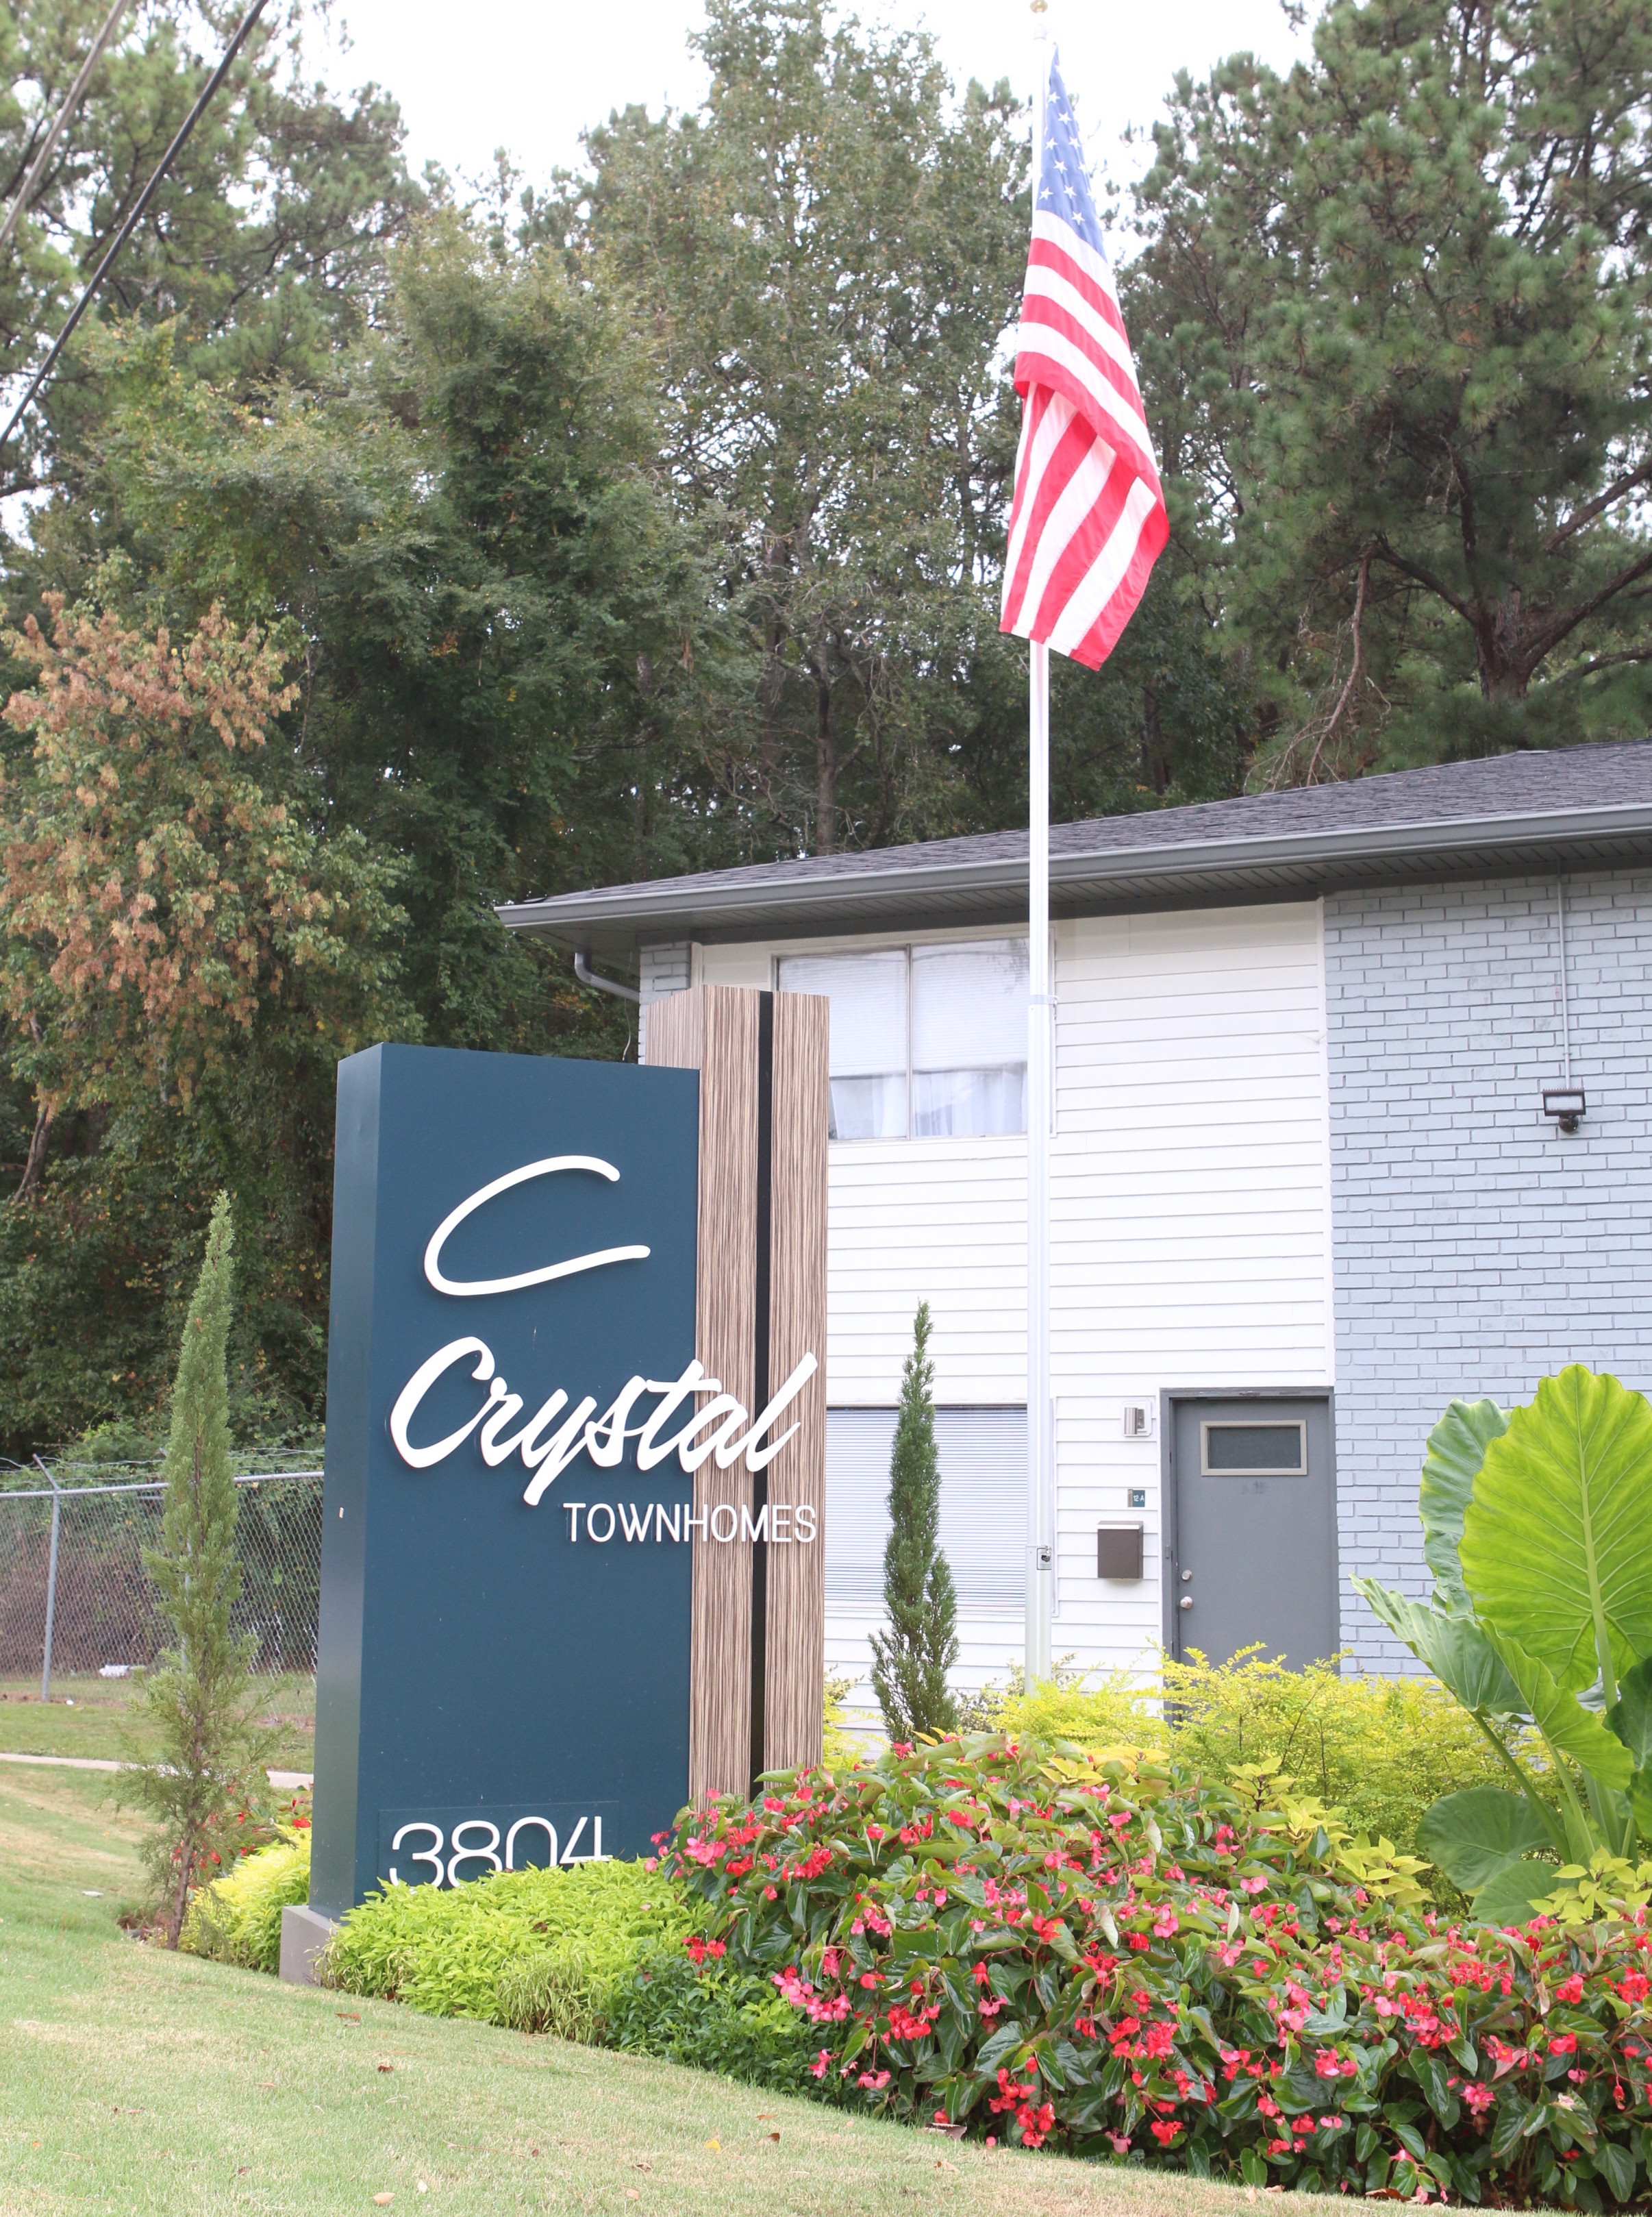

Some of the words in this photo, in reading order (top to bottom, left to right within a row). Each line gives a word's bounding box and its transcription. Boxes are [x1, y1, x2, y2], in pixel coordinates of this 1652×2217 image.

[424, 1155, 651, 1296] C
[390, 1337, 818, 1505] Crystal
[563, 1503, 816, 1542] TOWNHOMES
[389, 1816, 613, 1892] 3804
